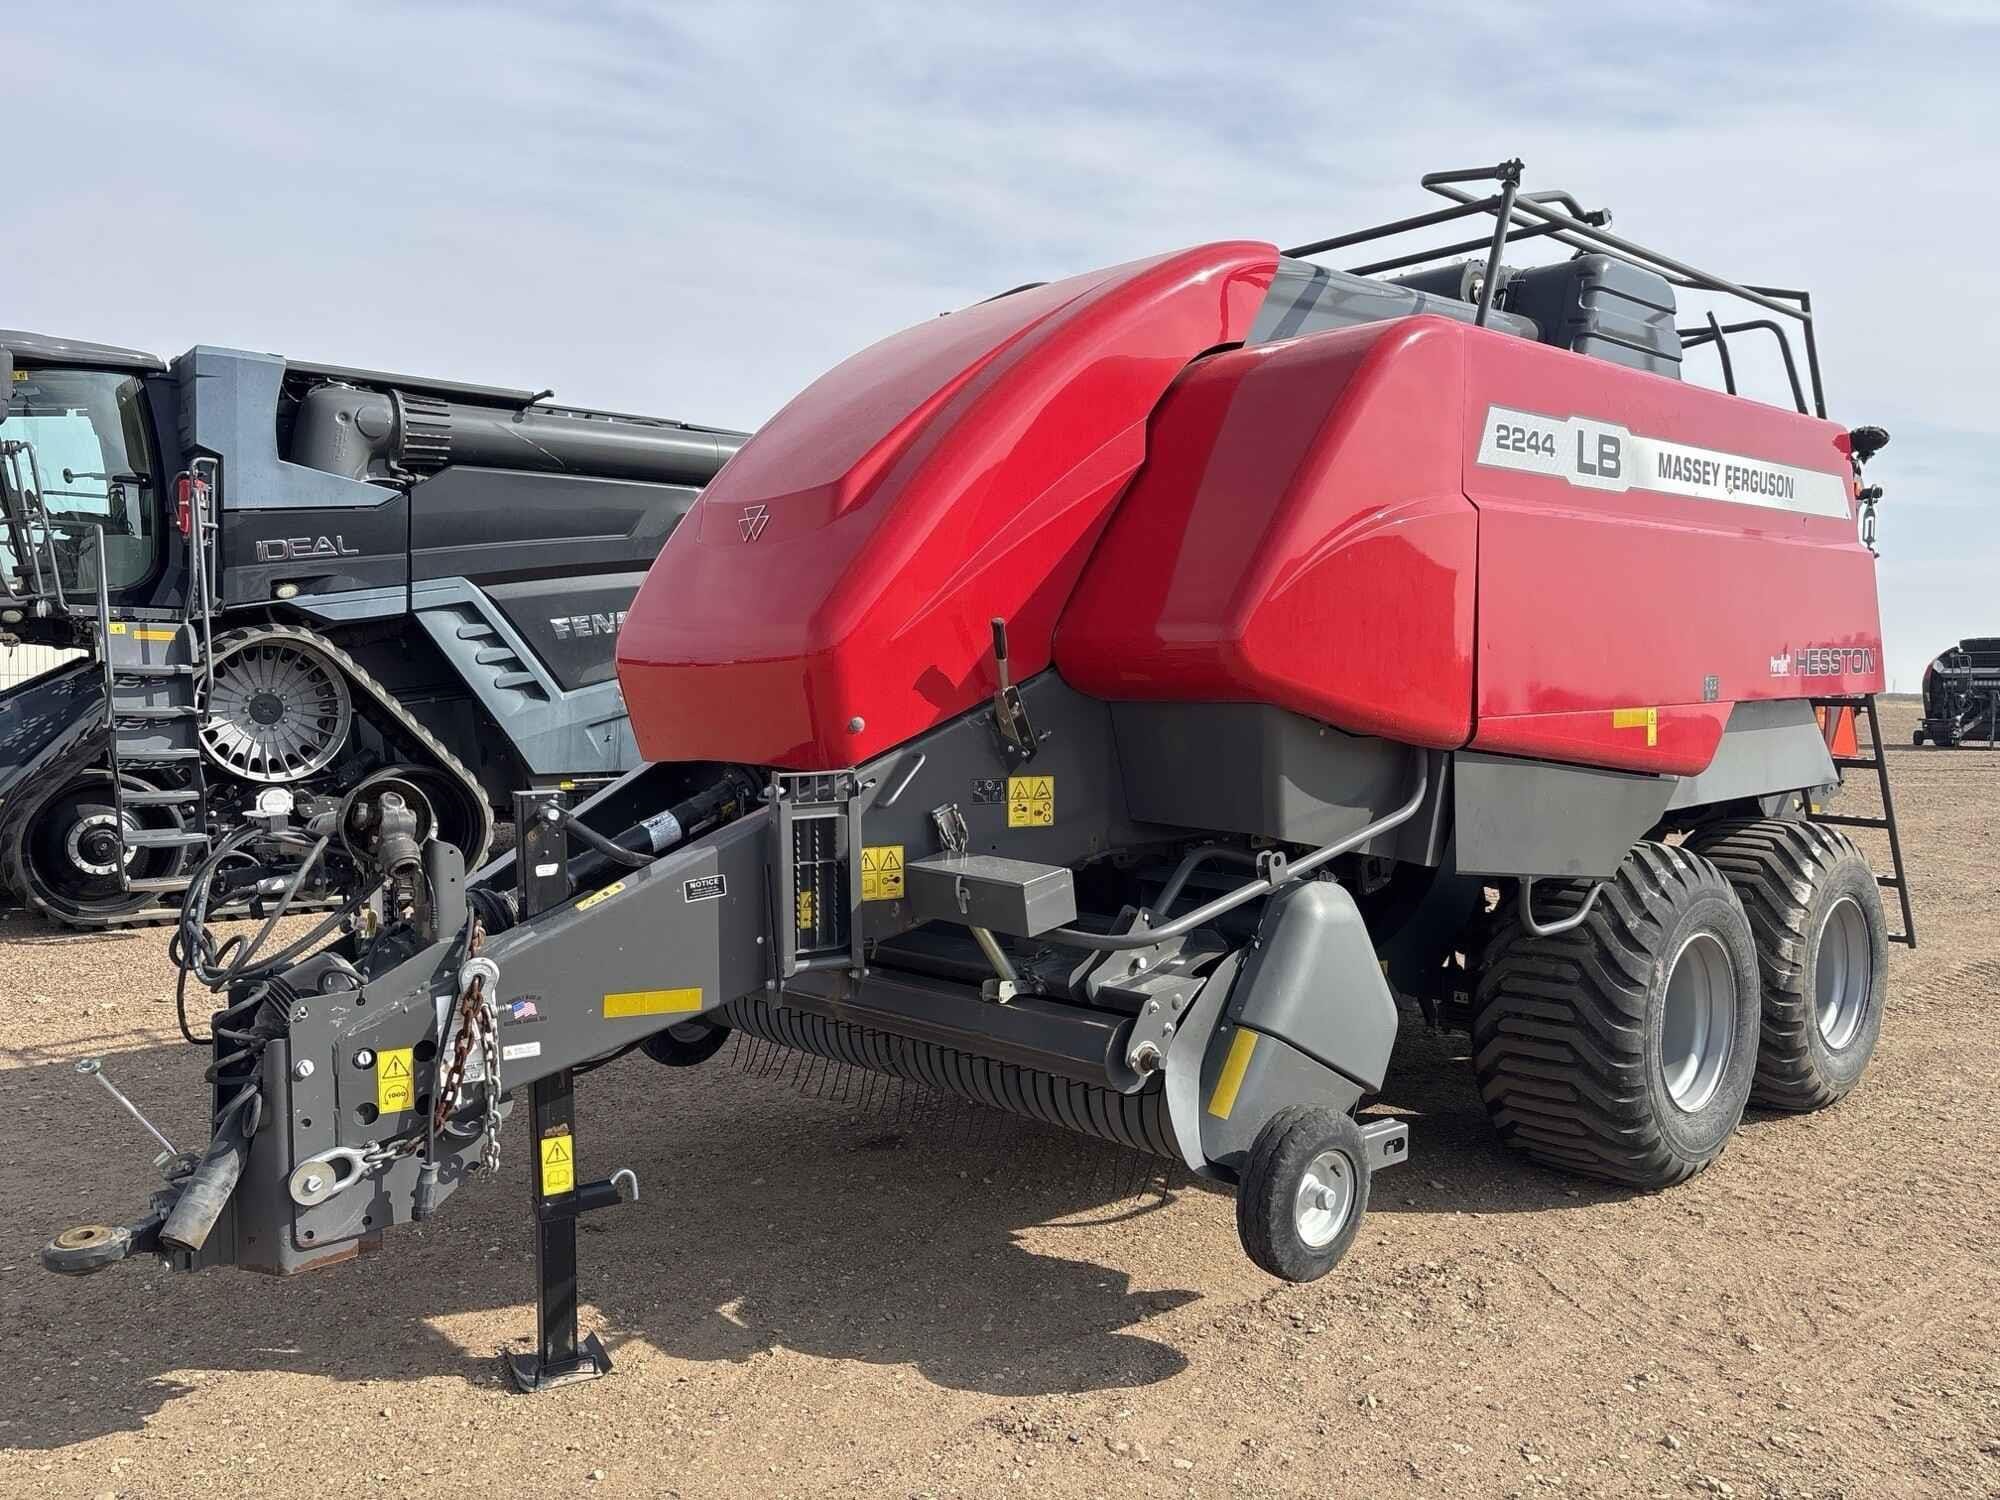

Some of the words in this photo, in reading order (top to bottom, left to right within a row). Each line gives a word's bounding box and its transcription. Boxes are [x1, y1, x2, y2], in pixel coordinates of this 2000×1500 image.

[1496, 424, 1555, 457] 2244
[1577, 430, 1621, 479] LB
[1658, 452, 1720, 486] MASSEY
[1725, 464, 1794, 499] FERGUSON
[256, 536, 359, 561] IDEAL
[1794, 648, 1876, 676] HESSTON
[690, 878, 719, 889] NOTICE
